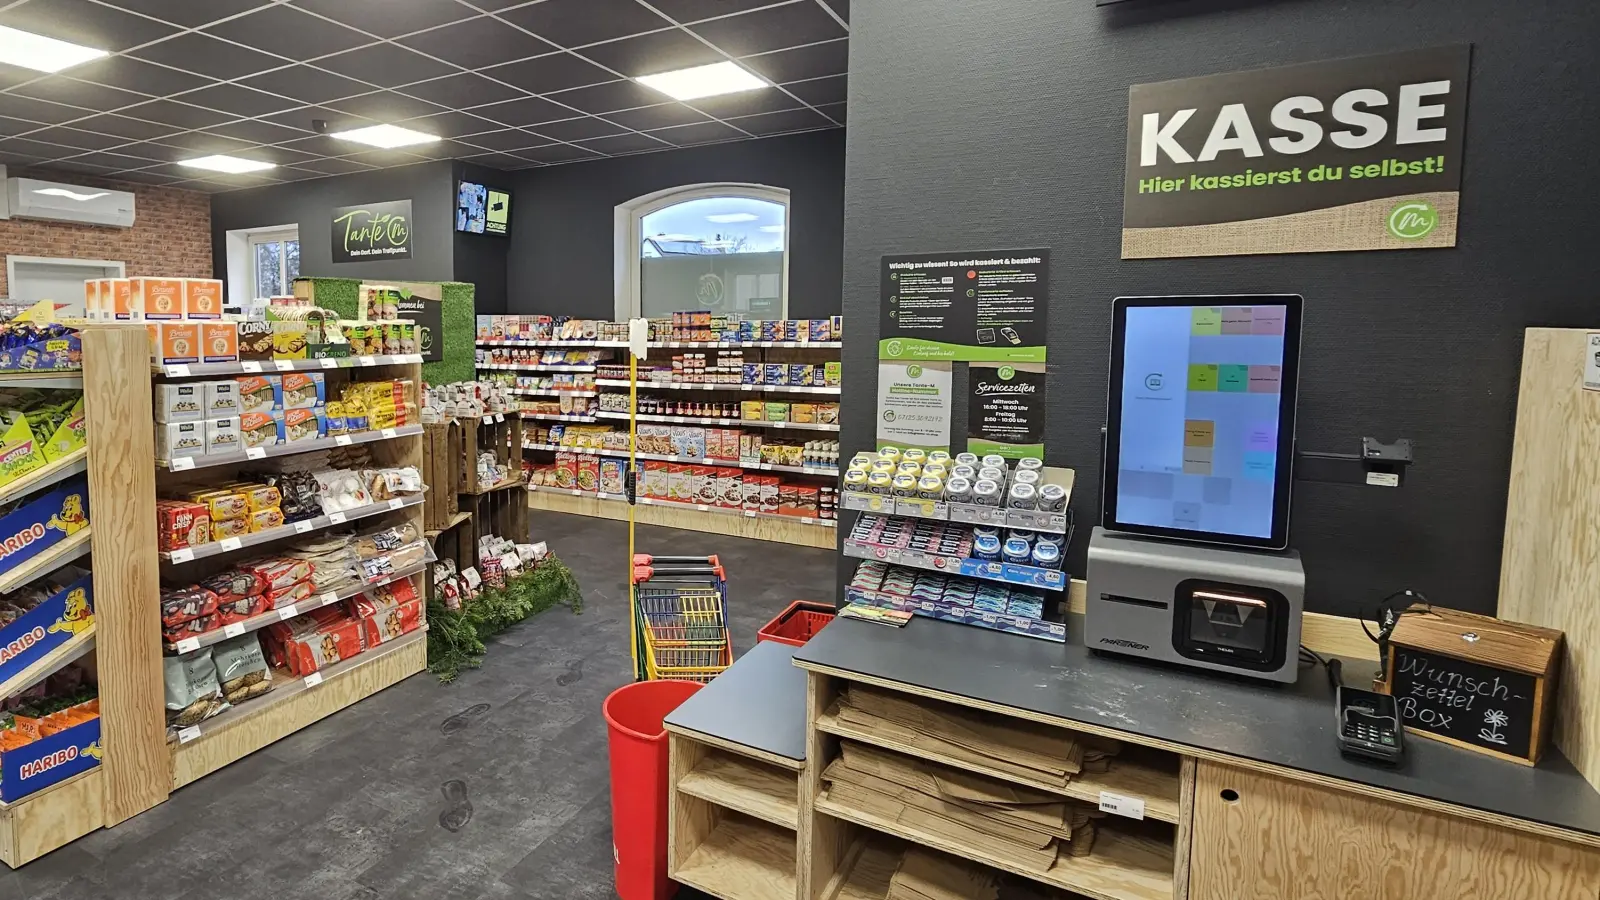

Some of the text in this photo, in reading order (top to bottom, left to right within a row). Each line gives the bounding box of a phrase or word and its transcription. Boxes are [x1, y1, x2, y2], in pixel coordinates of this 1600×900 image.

[1140, 80, 1450, 167] KASSE
[1139, 155, 1445, 194] Hier kassierst du selbst!
[334, 210, 386, 252] Tante
[889, 262, 914, 270] Wichtig
[923, 260, 949, 268] wissen!
[975, 258, 1003, 266] kassiert
[1011, 257, 1041, 265] bezahlt:
[238, 320, 273, 336] CORNY
[975, 381, 1035, 395] Servicezeiten
[172, 520, 191, 530] CRISP
[176, 513, 193, 522] FINN
[0, 522, 46, 561] ARIBO
[0, 626, 46, 663] ARIBO
[1399, 652, 1528, 701] Wunsch-
[1410, 680, 1475, 711] zettel
[20, 745, 78, 780] HARIBO
